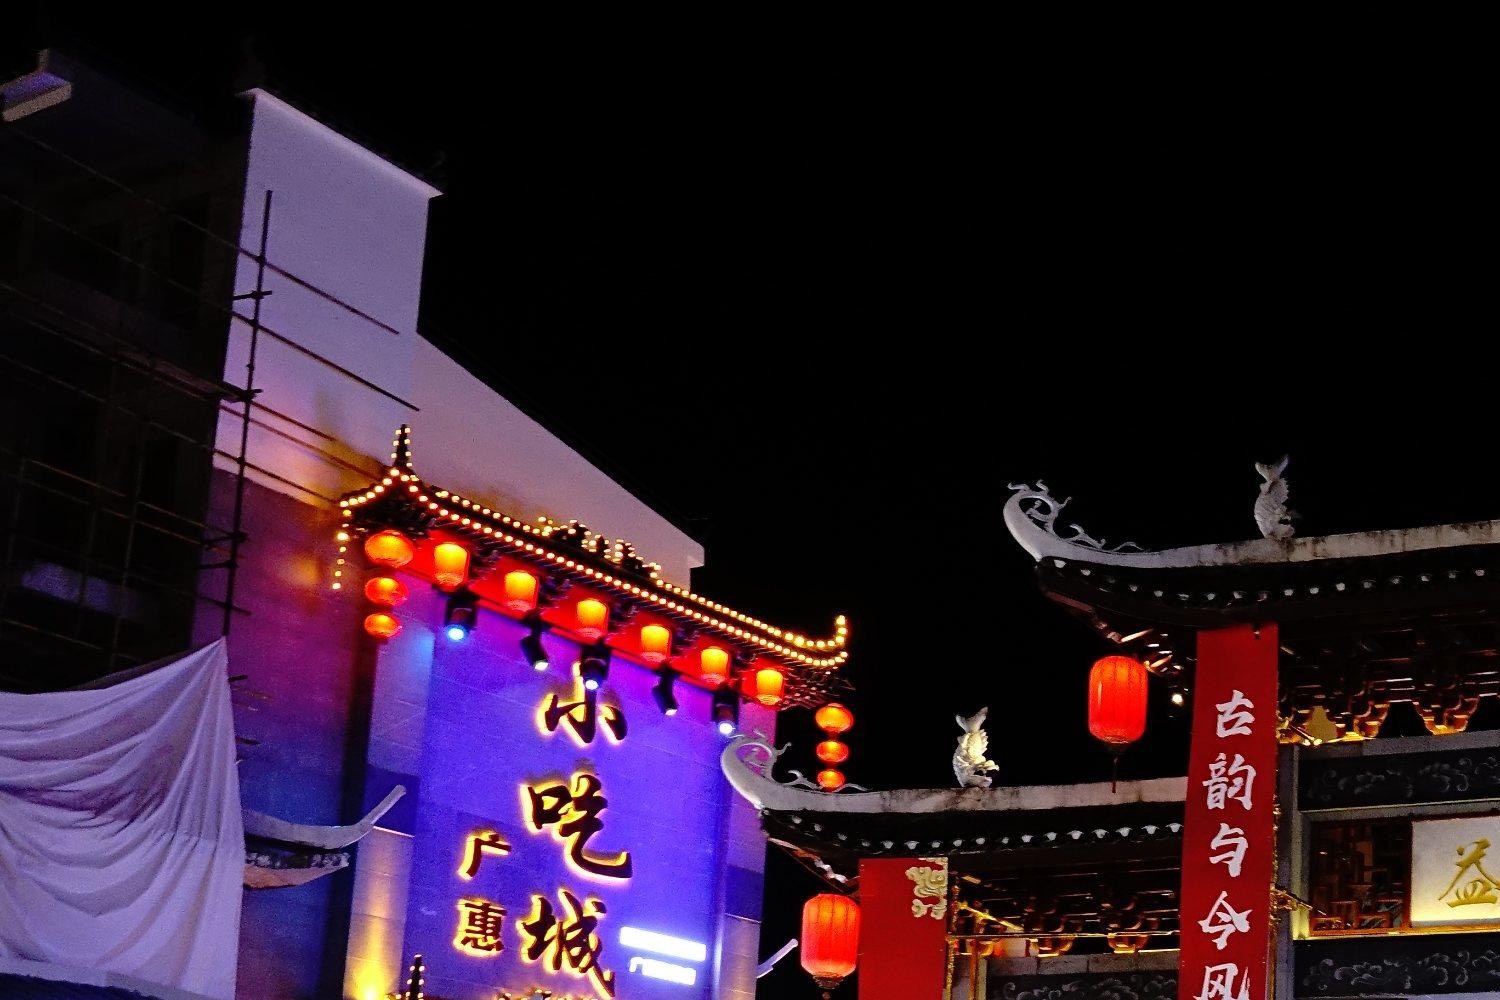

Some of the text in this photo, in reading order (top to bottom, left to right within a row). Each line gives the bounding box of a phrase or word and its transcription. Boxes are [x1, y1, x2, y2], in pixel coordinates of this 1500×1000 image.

[455, 832, 512, 955] 广惠
[519, 661, 632, 999] 小吃城
